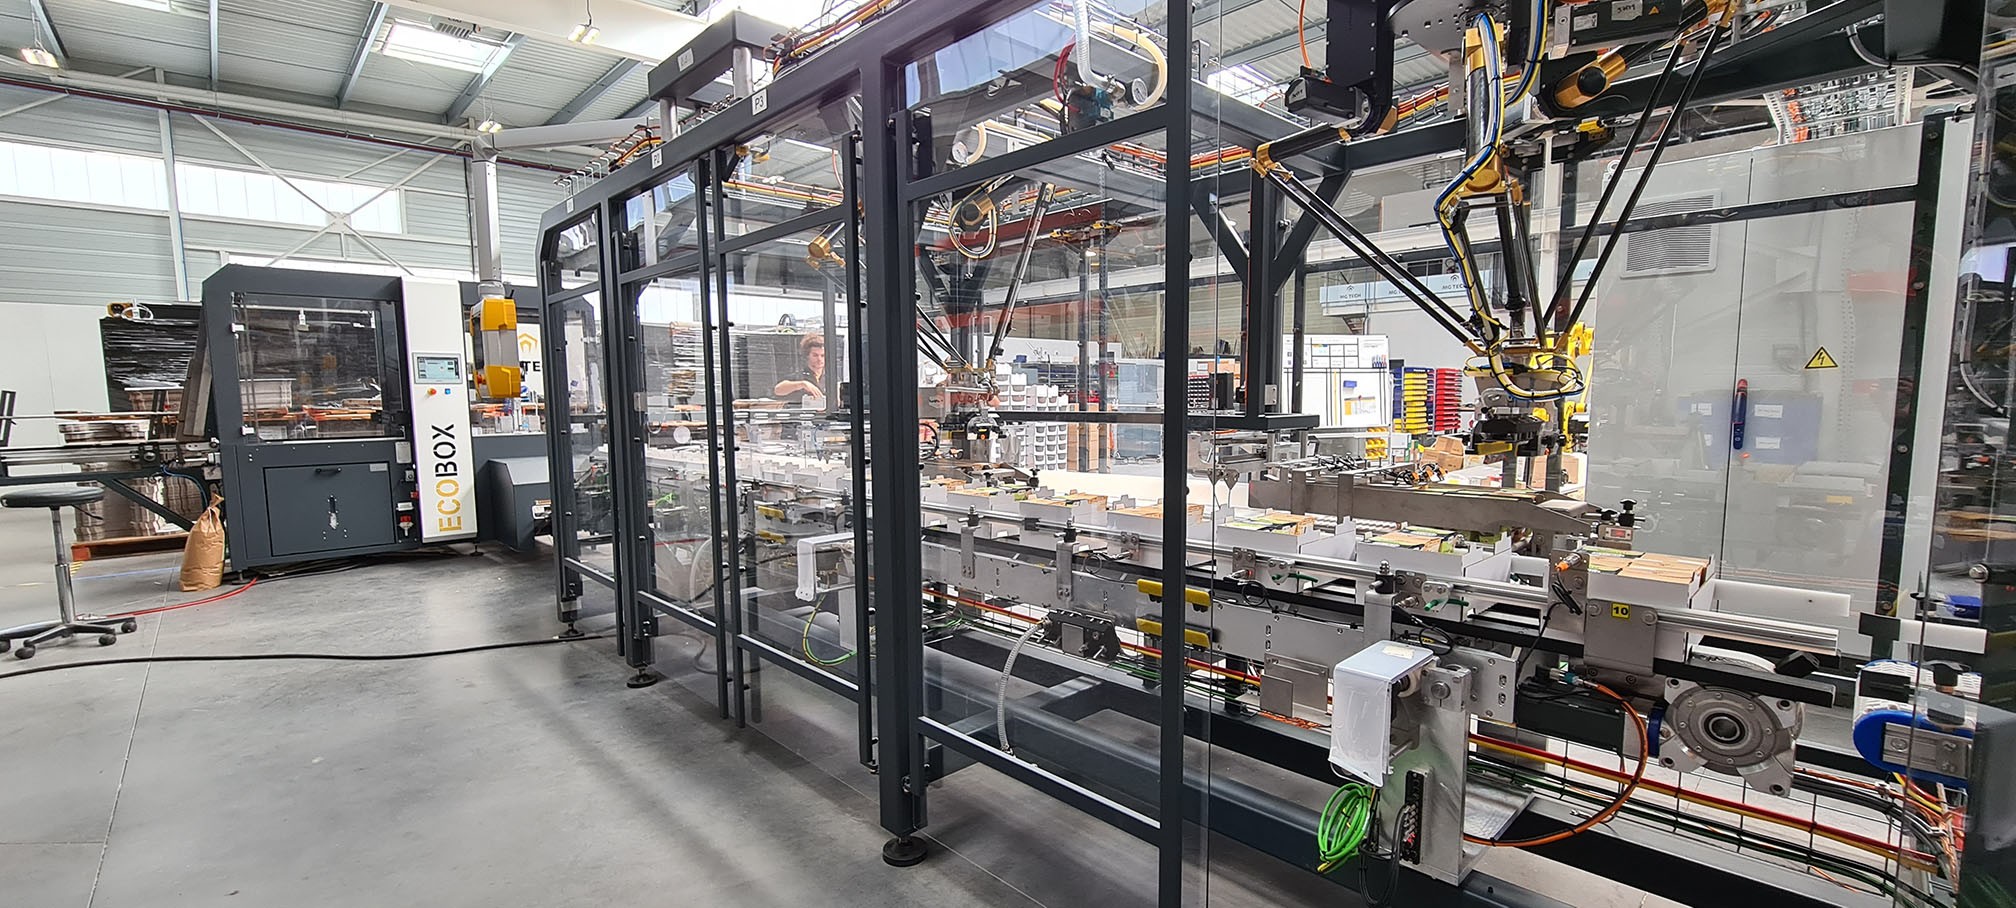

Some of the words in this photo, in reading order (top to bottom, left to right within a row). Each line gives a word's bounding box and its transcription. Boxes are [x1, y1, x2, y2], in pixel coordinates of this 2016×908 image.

[755, 95, 764, 110] P3
[522, 361, 541, 372] TE
[431, 423, 462, 532] ECOBOX
[1613, 606, 1628, 616] 10
